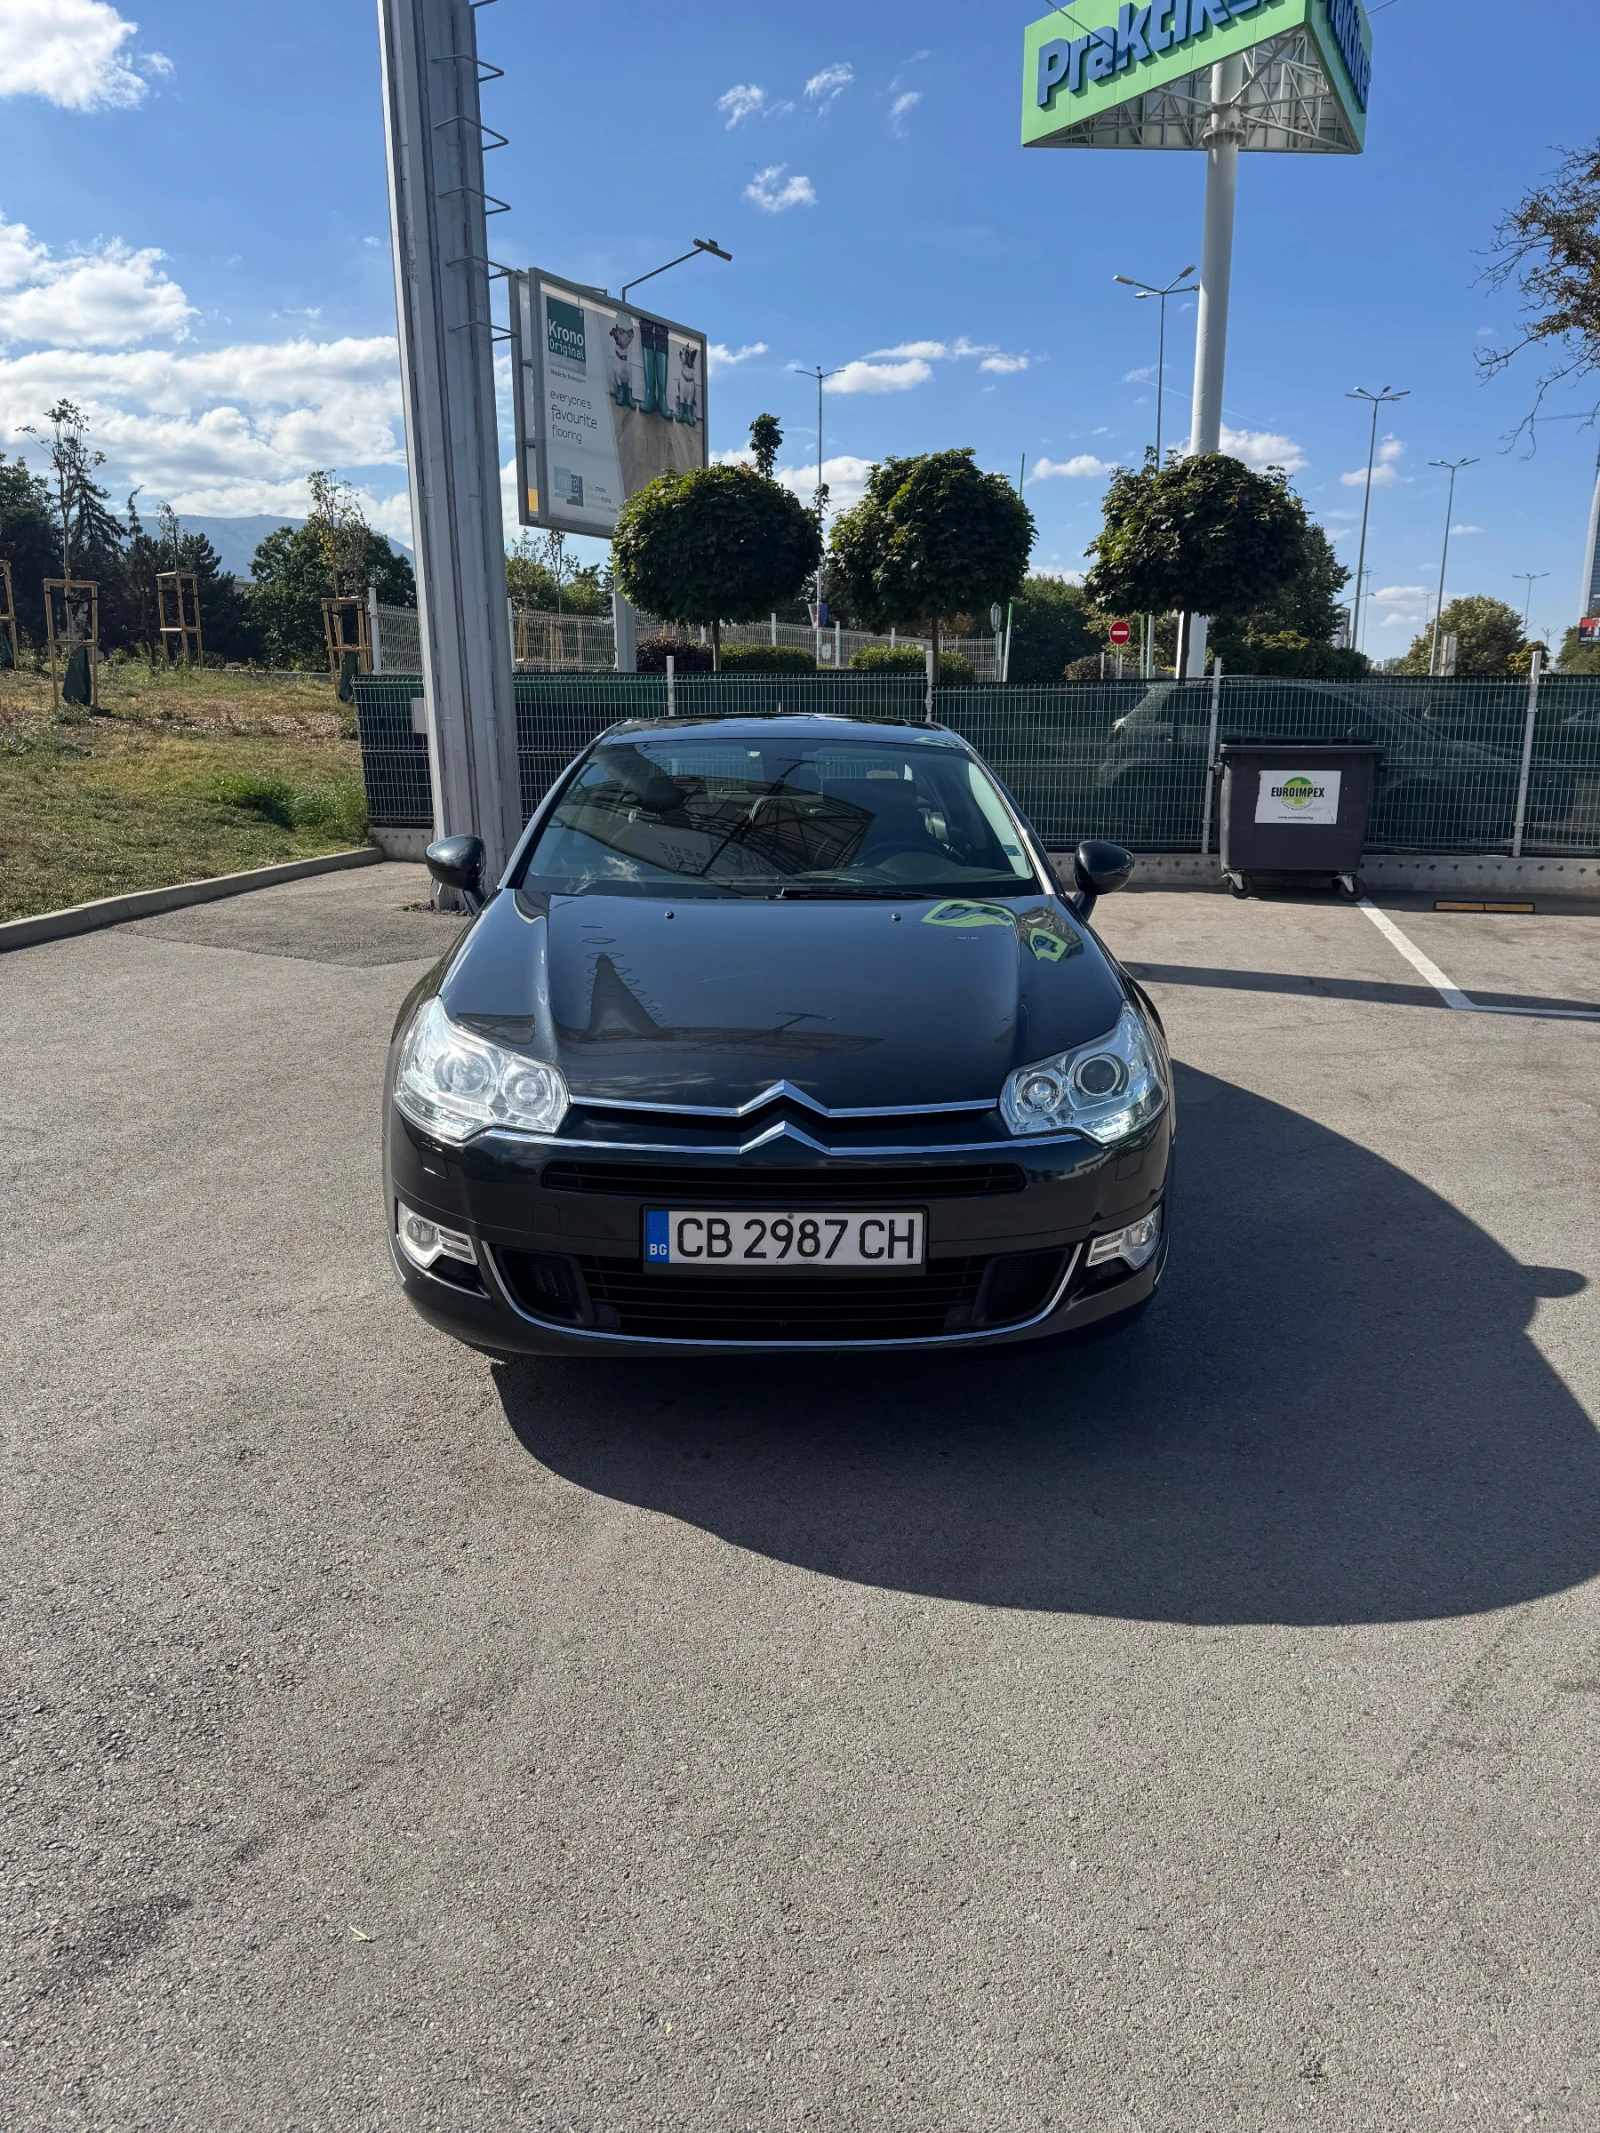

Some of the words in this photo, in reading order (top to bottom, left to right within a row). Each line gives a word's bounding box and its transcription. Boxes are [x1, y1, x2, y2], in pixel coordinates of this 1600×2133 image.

[1037, 0, 1270, 107] Praktik
[548, 319, 584, 347] Krono
[549, 338, 585, 360] Original
[550, 390, 591, 409] everyone's
[551, 404, 597, 429] favourite
[552, 424, 582, 444] flooring
[1271, 787, 1325, 798] EUROIMPEX
[677, 1218, 733, 1258] CB
[743, 1219, 849, 1259] 2987
[859, 1219, 915, 1259] CH
[649, 1244, 668, 1256] BG
